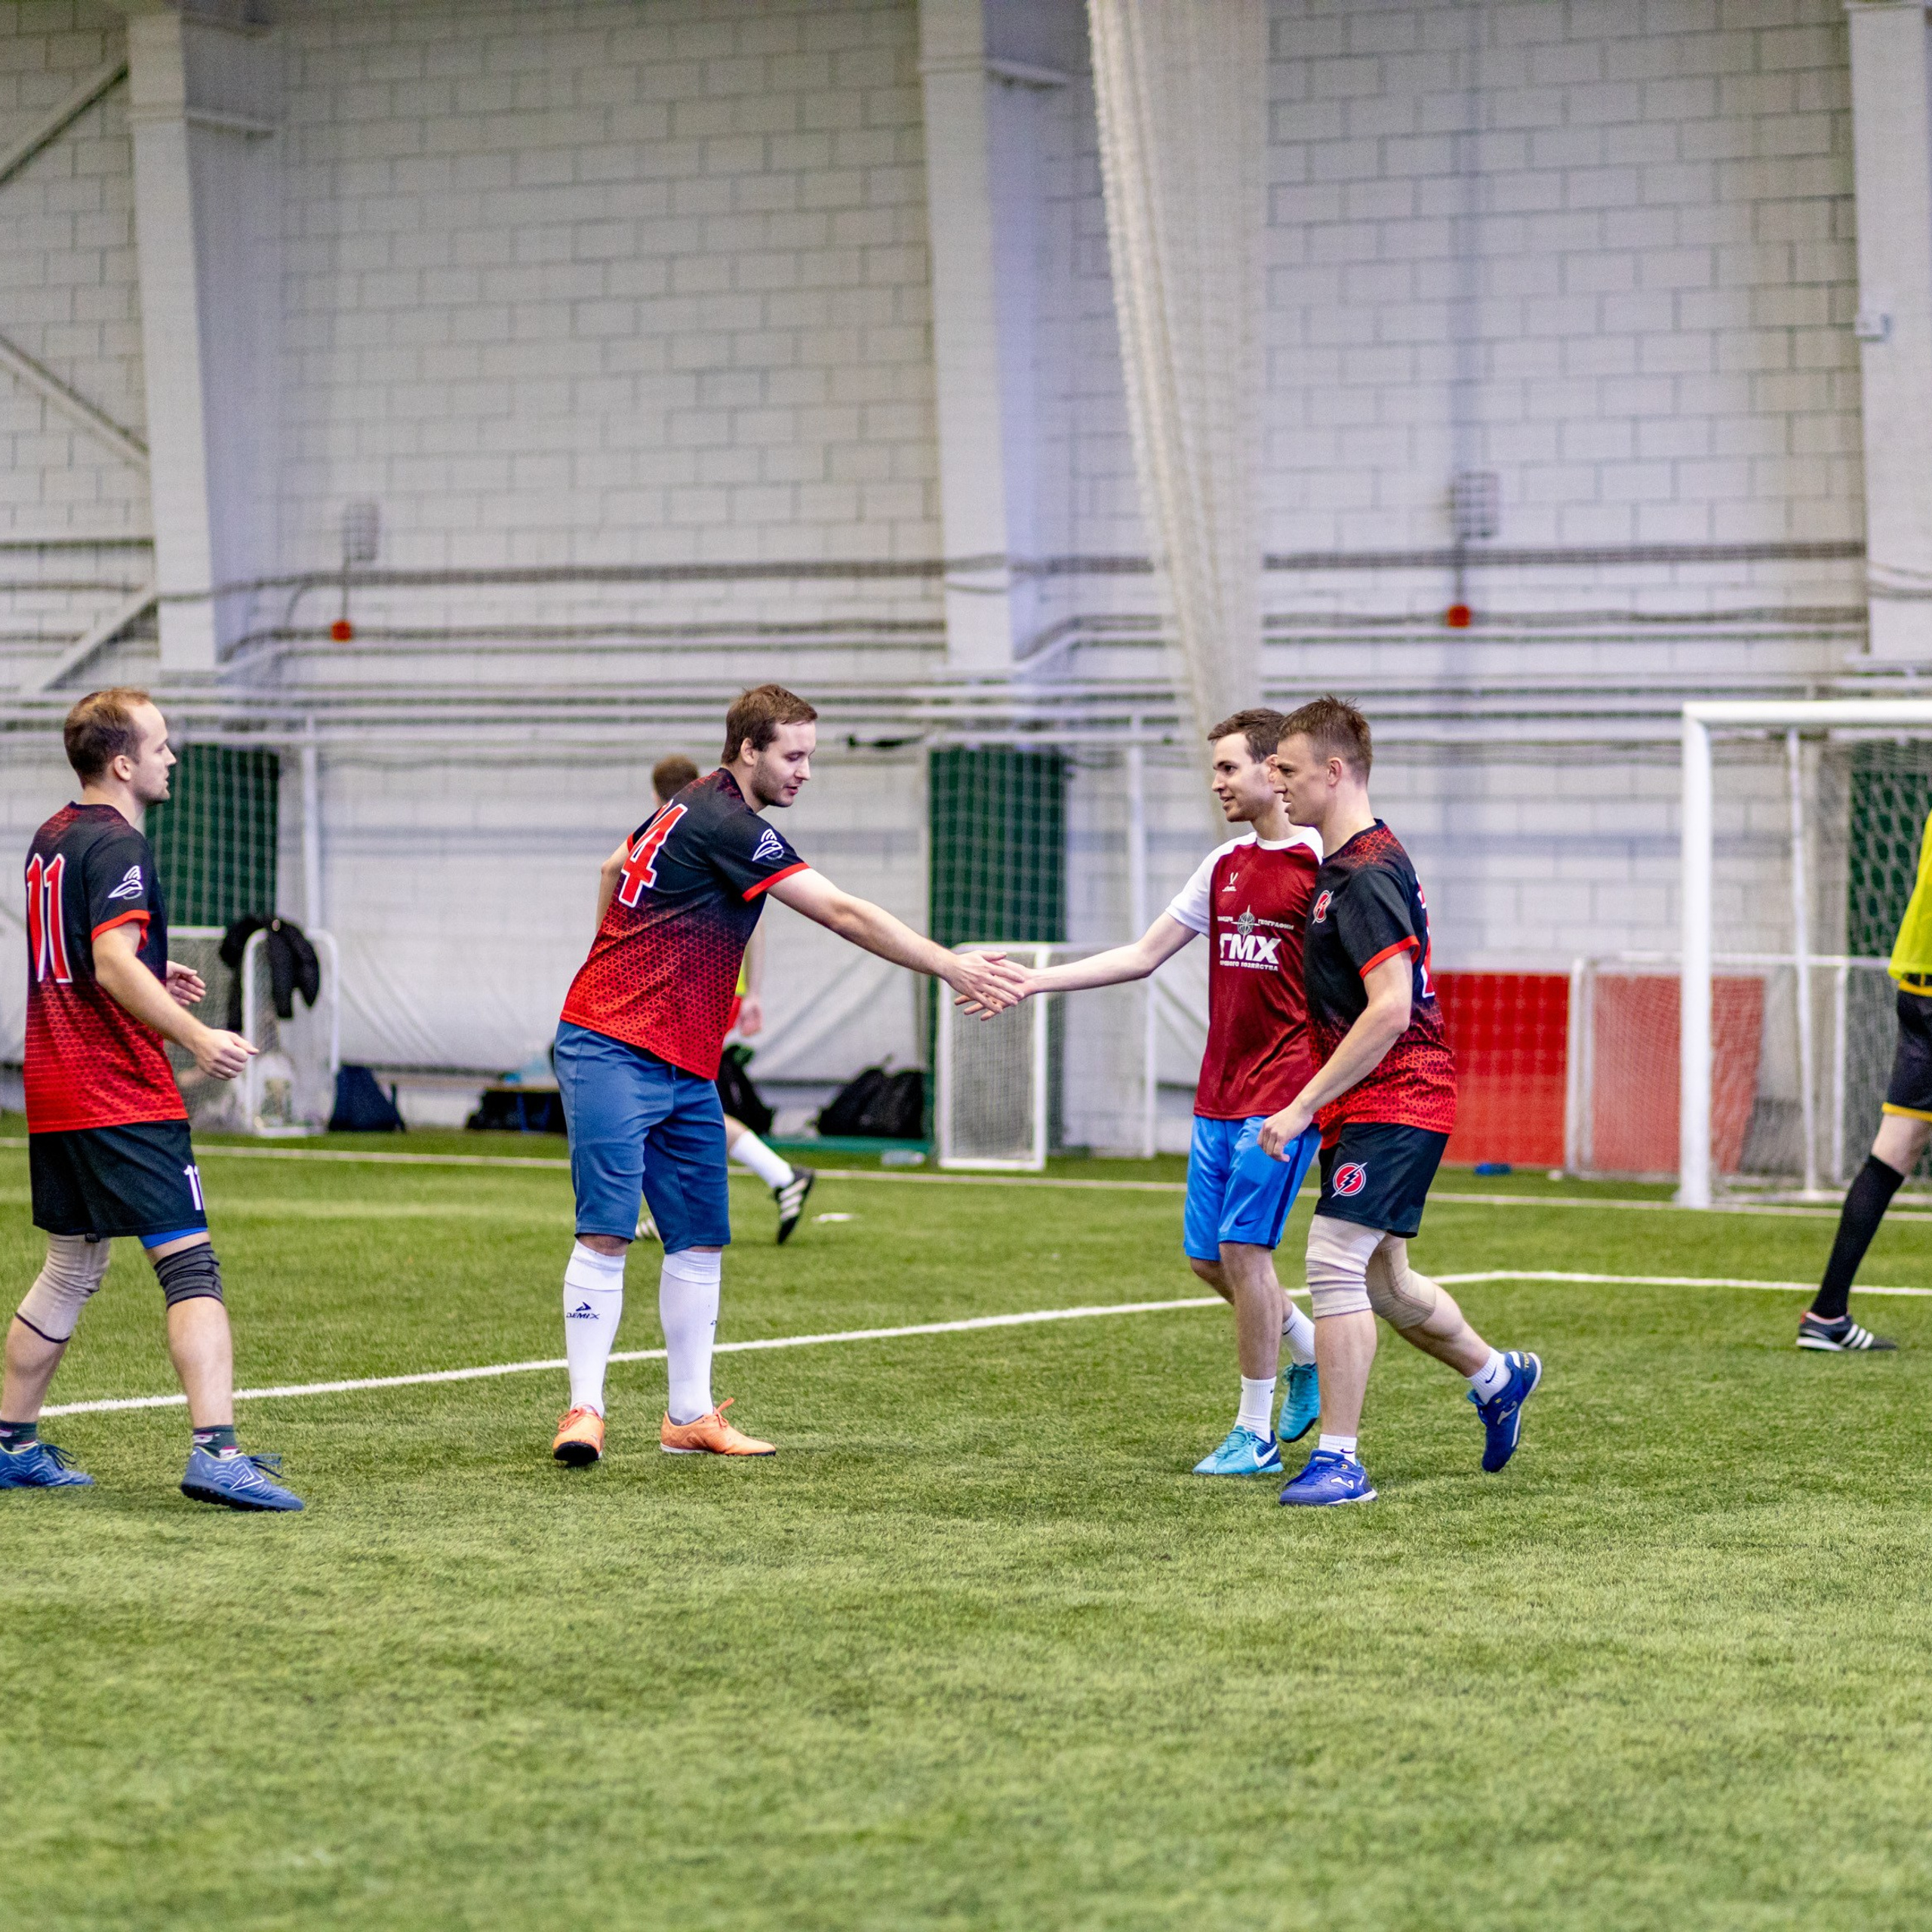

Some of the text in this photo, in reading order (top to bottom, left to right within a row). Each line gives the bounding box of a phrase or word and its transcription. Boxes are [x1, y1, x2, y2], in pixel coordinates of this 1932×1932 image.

[619, 798, 688, 908] 4
[26, 853, 72, 983] 11
[1220, 933, 1281, 964] ГМХ
